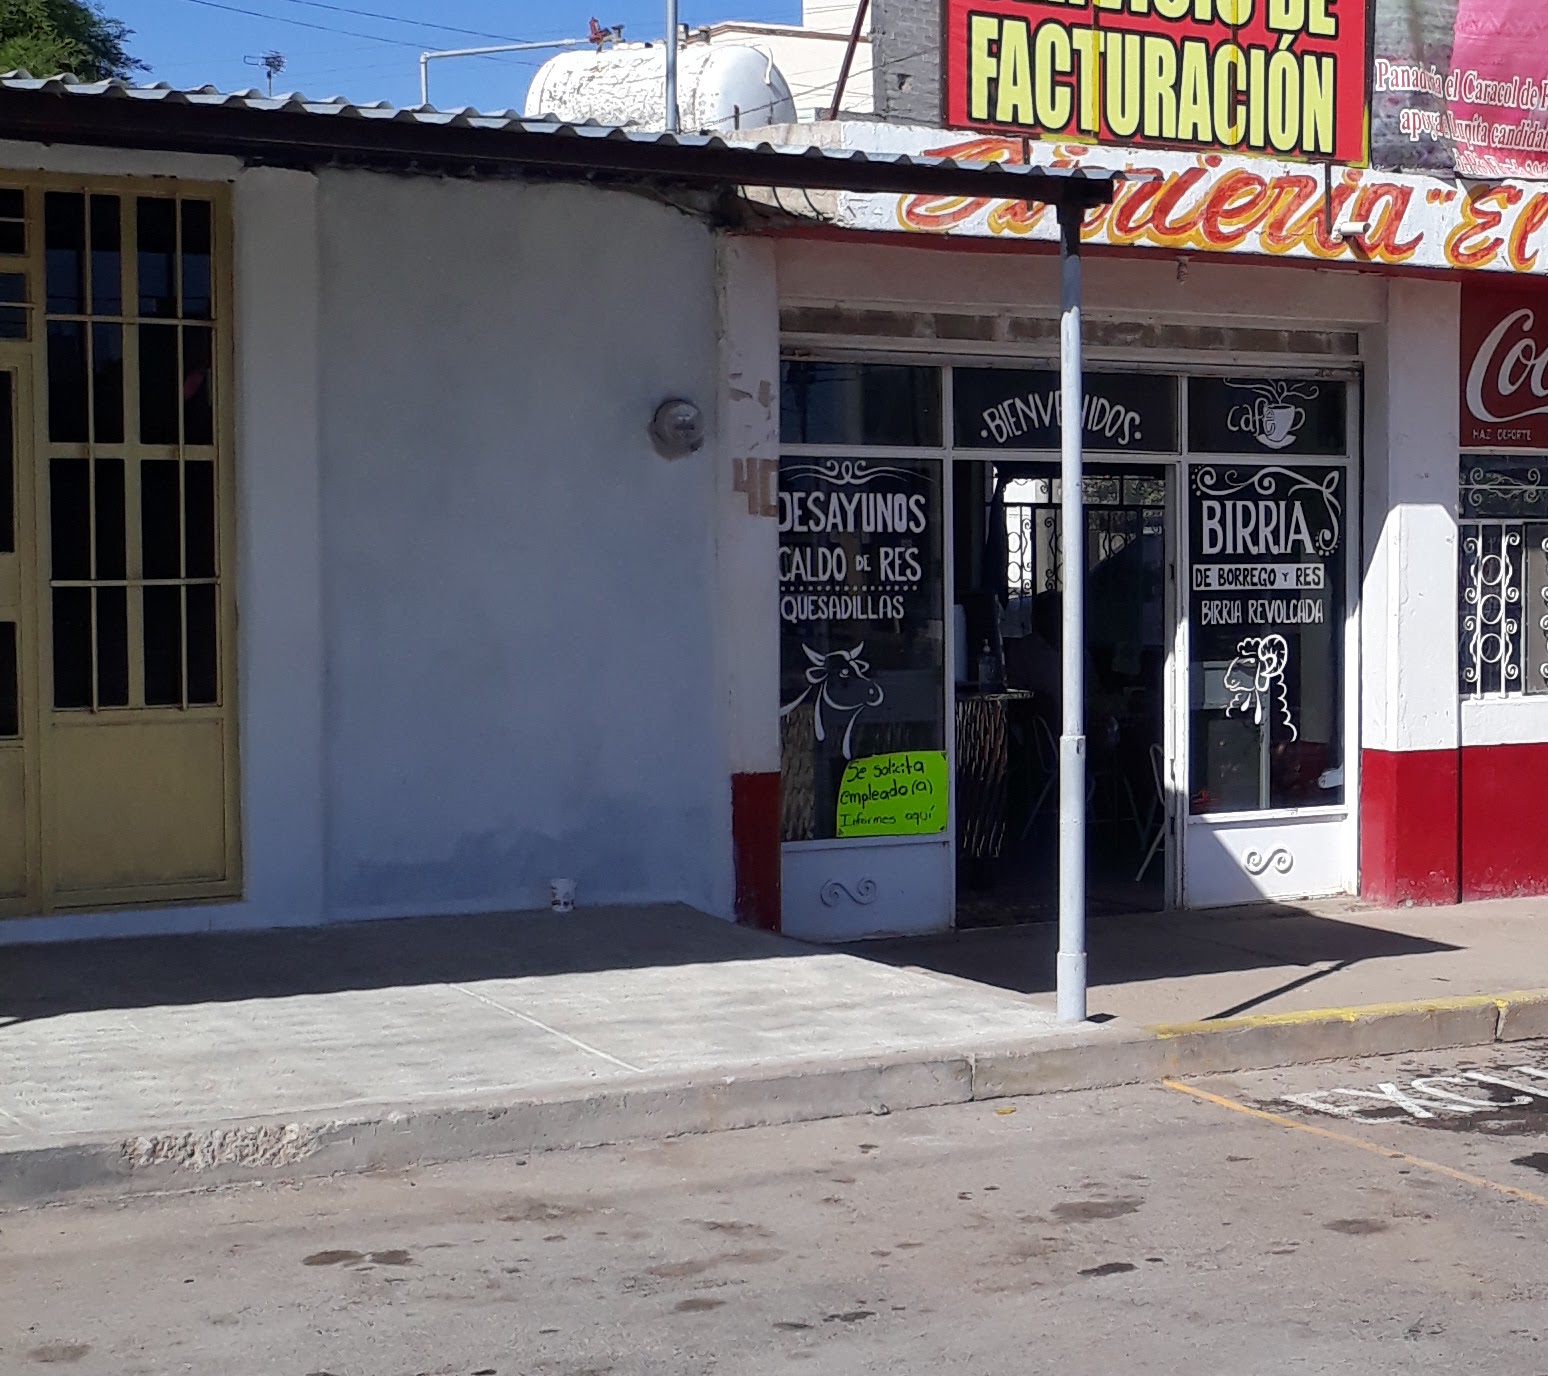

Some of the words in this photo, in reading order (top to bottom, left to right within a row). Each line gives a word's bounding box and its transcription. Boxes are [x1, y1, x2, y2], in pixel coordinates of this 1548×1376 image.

[967, 15, 1335, 155] FACTURACIÓN
[1445, 69, 1459, 98] el
[1461, 70, 1518, 107] Caracol
[1520, 78, 1538, 109] de
[1473, 429, 1491, 440] HAZ
[779, 491, 926, 533] DESAYUNOS
[1201, 500, 1316, 555] BIRRIA
[779, 546, 847, 581] CALDO
[855, 554, 871, 572] DE
[879, 547, 922, 582] RES
[1195, 567, 1211, 587] DE
[1218, 567, 1276, 587] BORREGO
[1281, 572, 1290, 582] Y
[1295, 566, 1322, 586] RES
[780, 594, 905, 624] QUESADILLAS
[1201, 599, 1242, 625] BIRRIA
[1248, 599, 1324, 624] REVOLCADA
[847, 760, 867, 782] Se
[873, 755, 924, 778] solicita
[840, 778, 933, 810] empleado(a)
[840, 811, 896, 827] Informes
[905, 804, 935, 825] aquí
